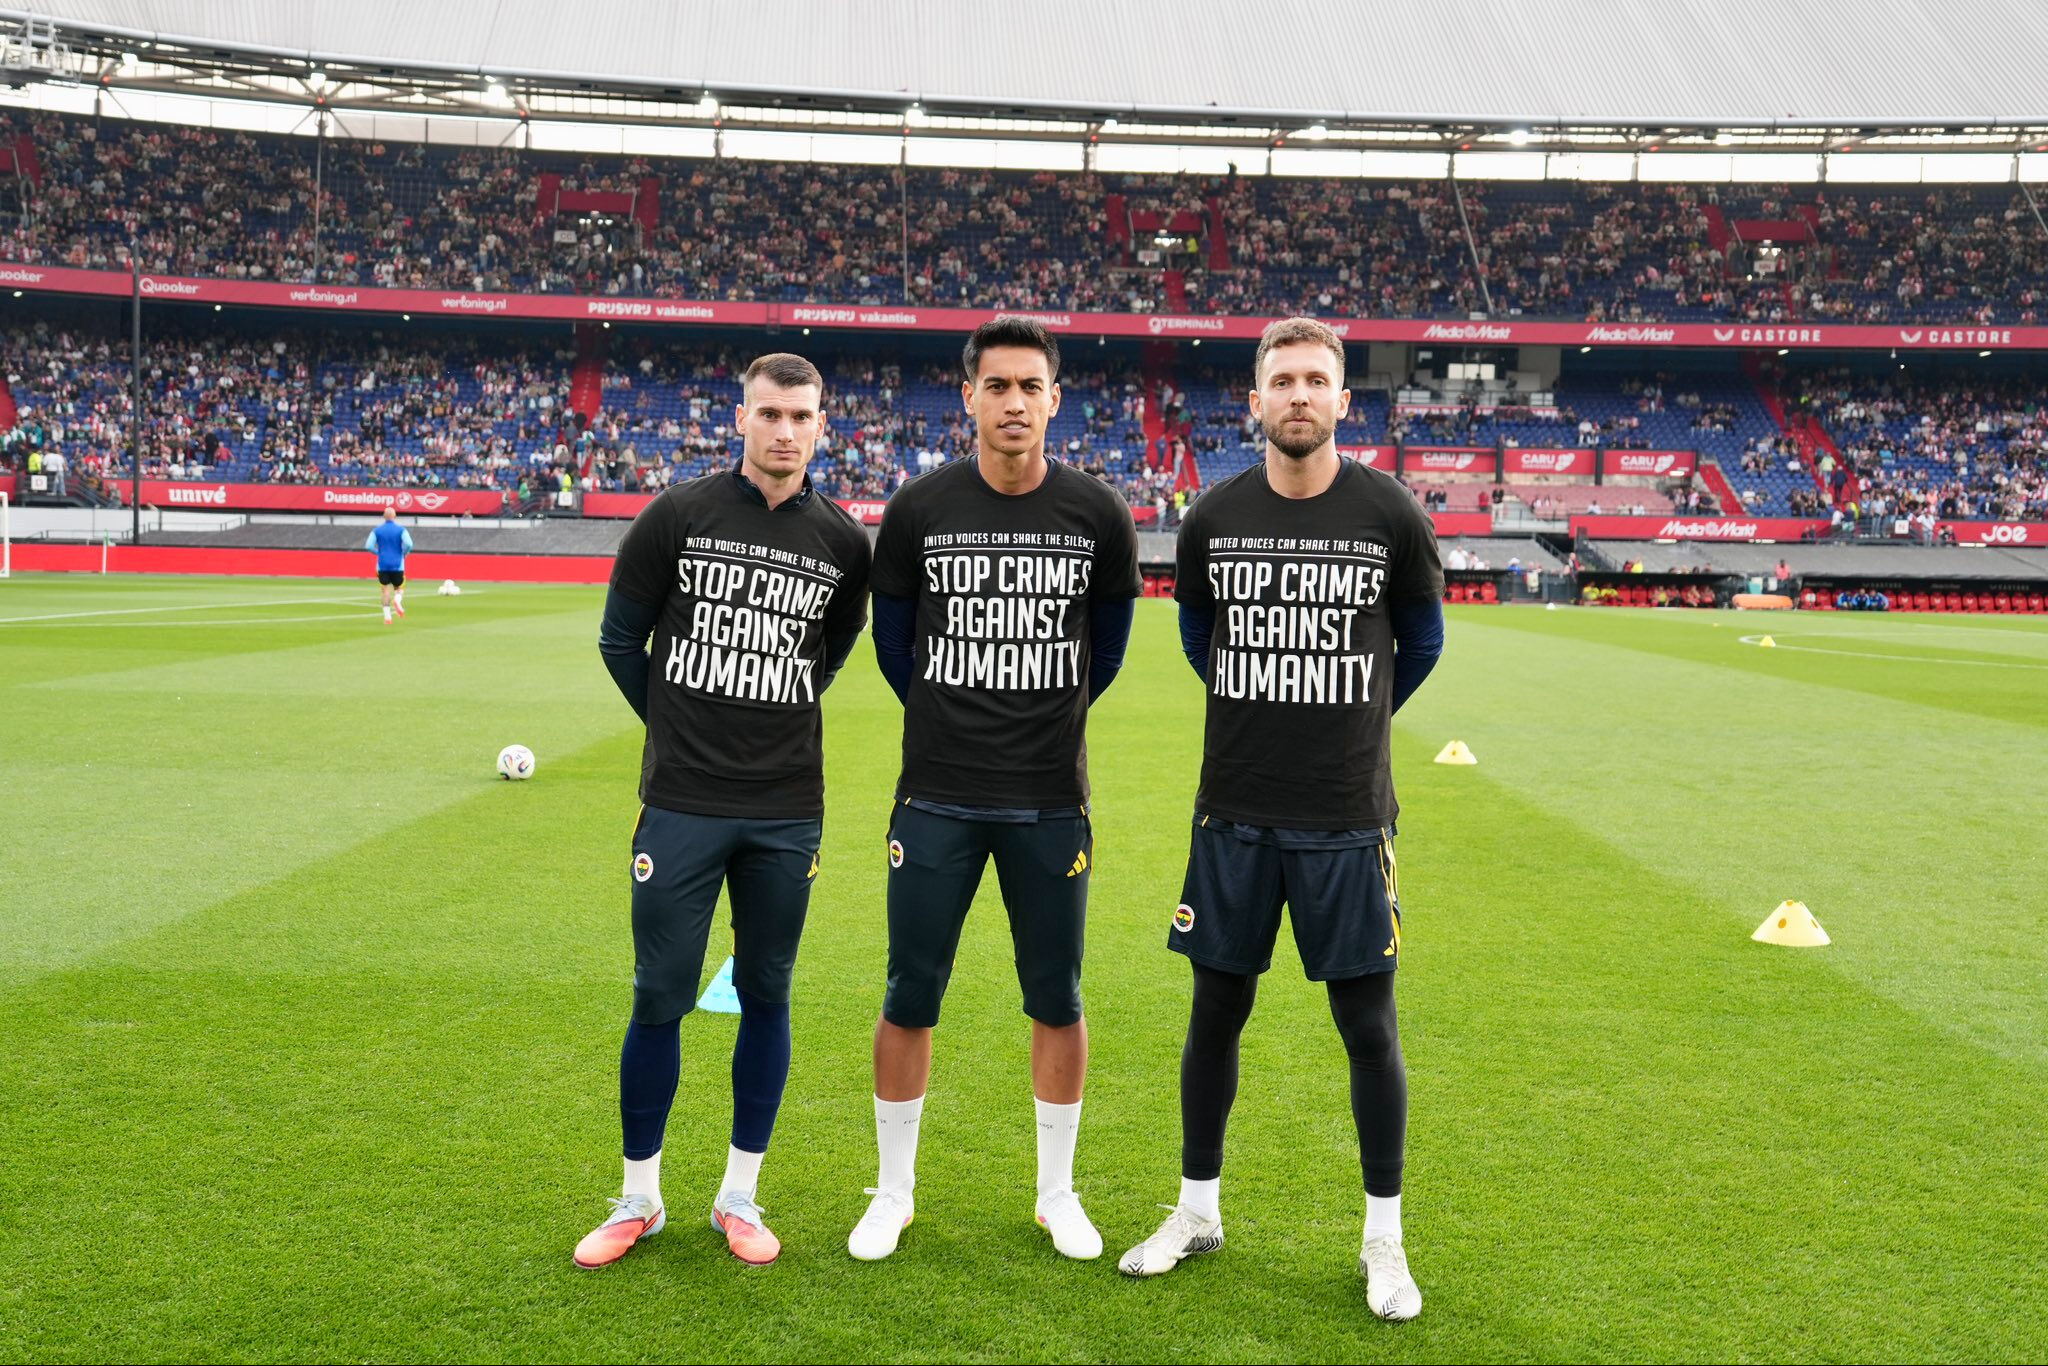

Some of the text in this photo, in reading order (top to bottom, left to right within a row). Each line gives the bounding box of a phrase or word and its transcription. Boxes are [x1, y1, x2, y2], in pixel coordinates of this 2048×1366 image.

[139, 277, 199, 295] Quooker
[290, 289, 357, 305] vertoning.nl
[442, 296, 507, 311] vertoning.nl
[656, 304, 714, 318] vakanties
[859, 311, 917, 324] vakanties
[1741, 329, 1821, 342] CASTORE
[1928, 330, 2012, 344] CASTORE
[1521, 453, 1555, 464] CARU
[1620, 455, 1655, 466] CARU
[168, 486, 227, 503] univé
[324, 491, 394, 506] Dusseldorp
[956, 532, 989, 544] VOICES
[991, 533, 1010, 544] CAN
[1012, 533, 1042, 545] SHAKE
[1045, 533, 1061, 545] THE
[1064, 535, 1096, 551] SILENCE
[1209, 537, 1389, 558] UNITED VOICES CAN SHAKE THE SILENCE
[685, 537, 712, 549] NITED
[715, 539, 747, 554] VOICES
[749, 545, 768, 558] CAN
[770, 548, 799, 565] SHAKE
[801, 555, 818, 570] THE
[678, 558, 746, 602] STOP
[924, 555, 1092, 596] STOP CRIMES
[1208, 561, 1385, 606] STOP CRIMES
[946, 596, 1071, 639] AGAINST
[690, 600, 808, 658] AGAINST
[1228, 604, 1358, 651] AGAINST
[665, 636, 817, 704] HUMANITY
[923, 635, 1081, 690] HUMANITY
[1213, 647, 1374, 704] HUMANITY
